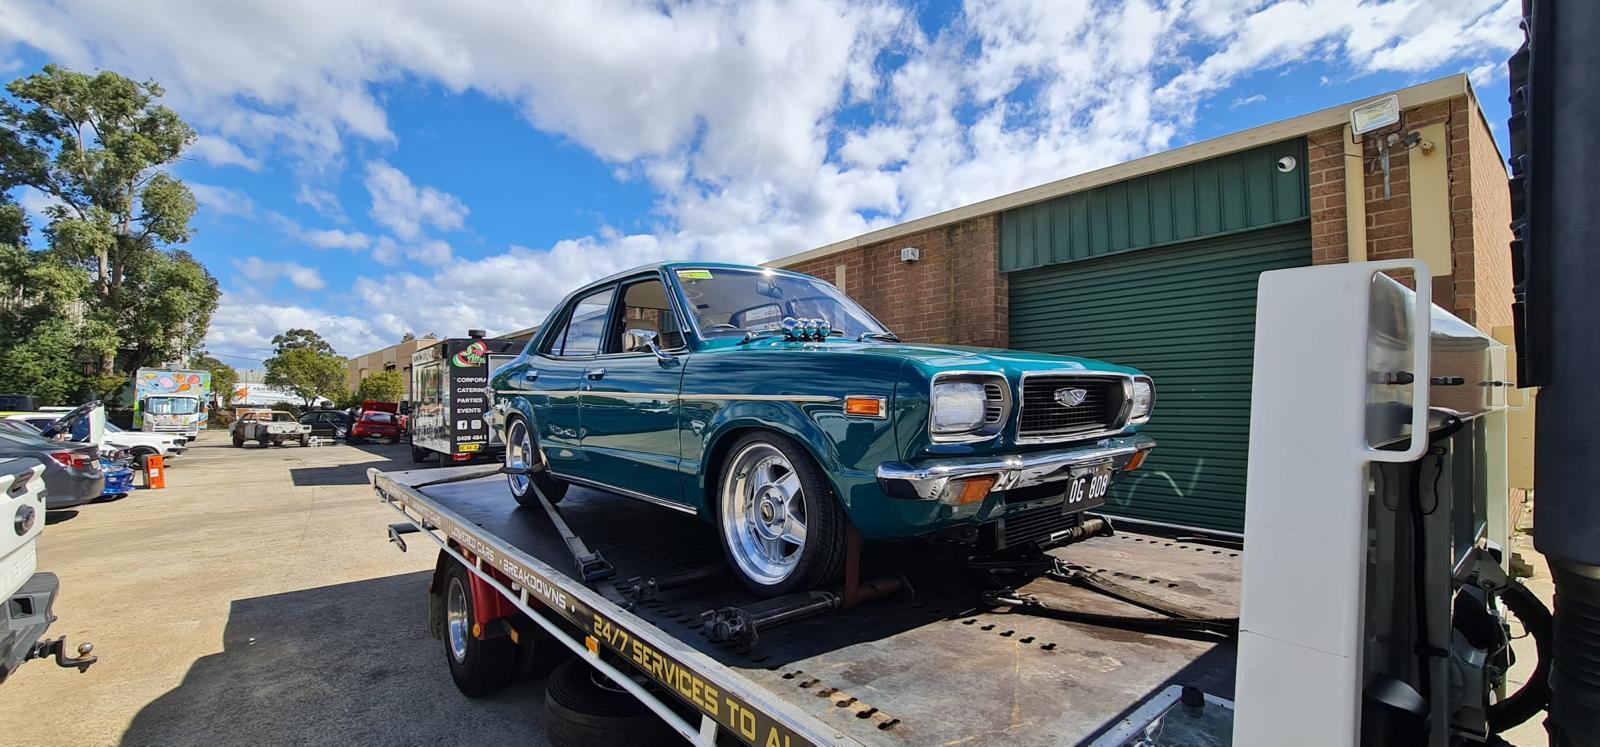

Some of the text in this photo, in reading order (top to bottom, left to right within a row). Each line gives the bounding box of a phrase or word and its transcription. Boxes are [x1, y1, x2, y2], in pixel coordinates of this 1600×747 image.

[1088, 474, 1109, 499] 808
[477, 541, 495, 562] CARS
[503, 558, 566, 610] BREAKDOWNS
[593, 614, 629, 652] 24/7
[632, 639, 719, 717] SERVICES
[725, 697, 756, 742] TO
